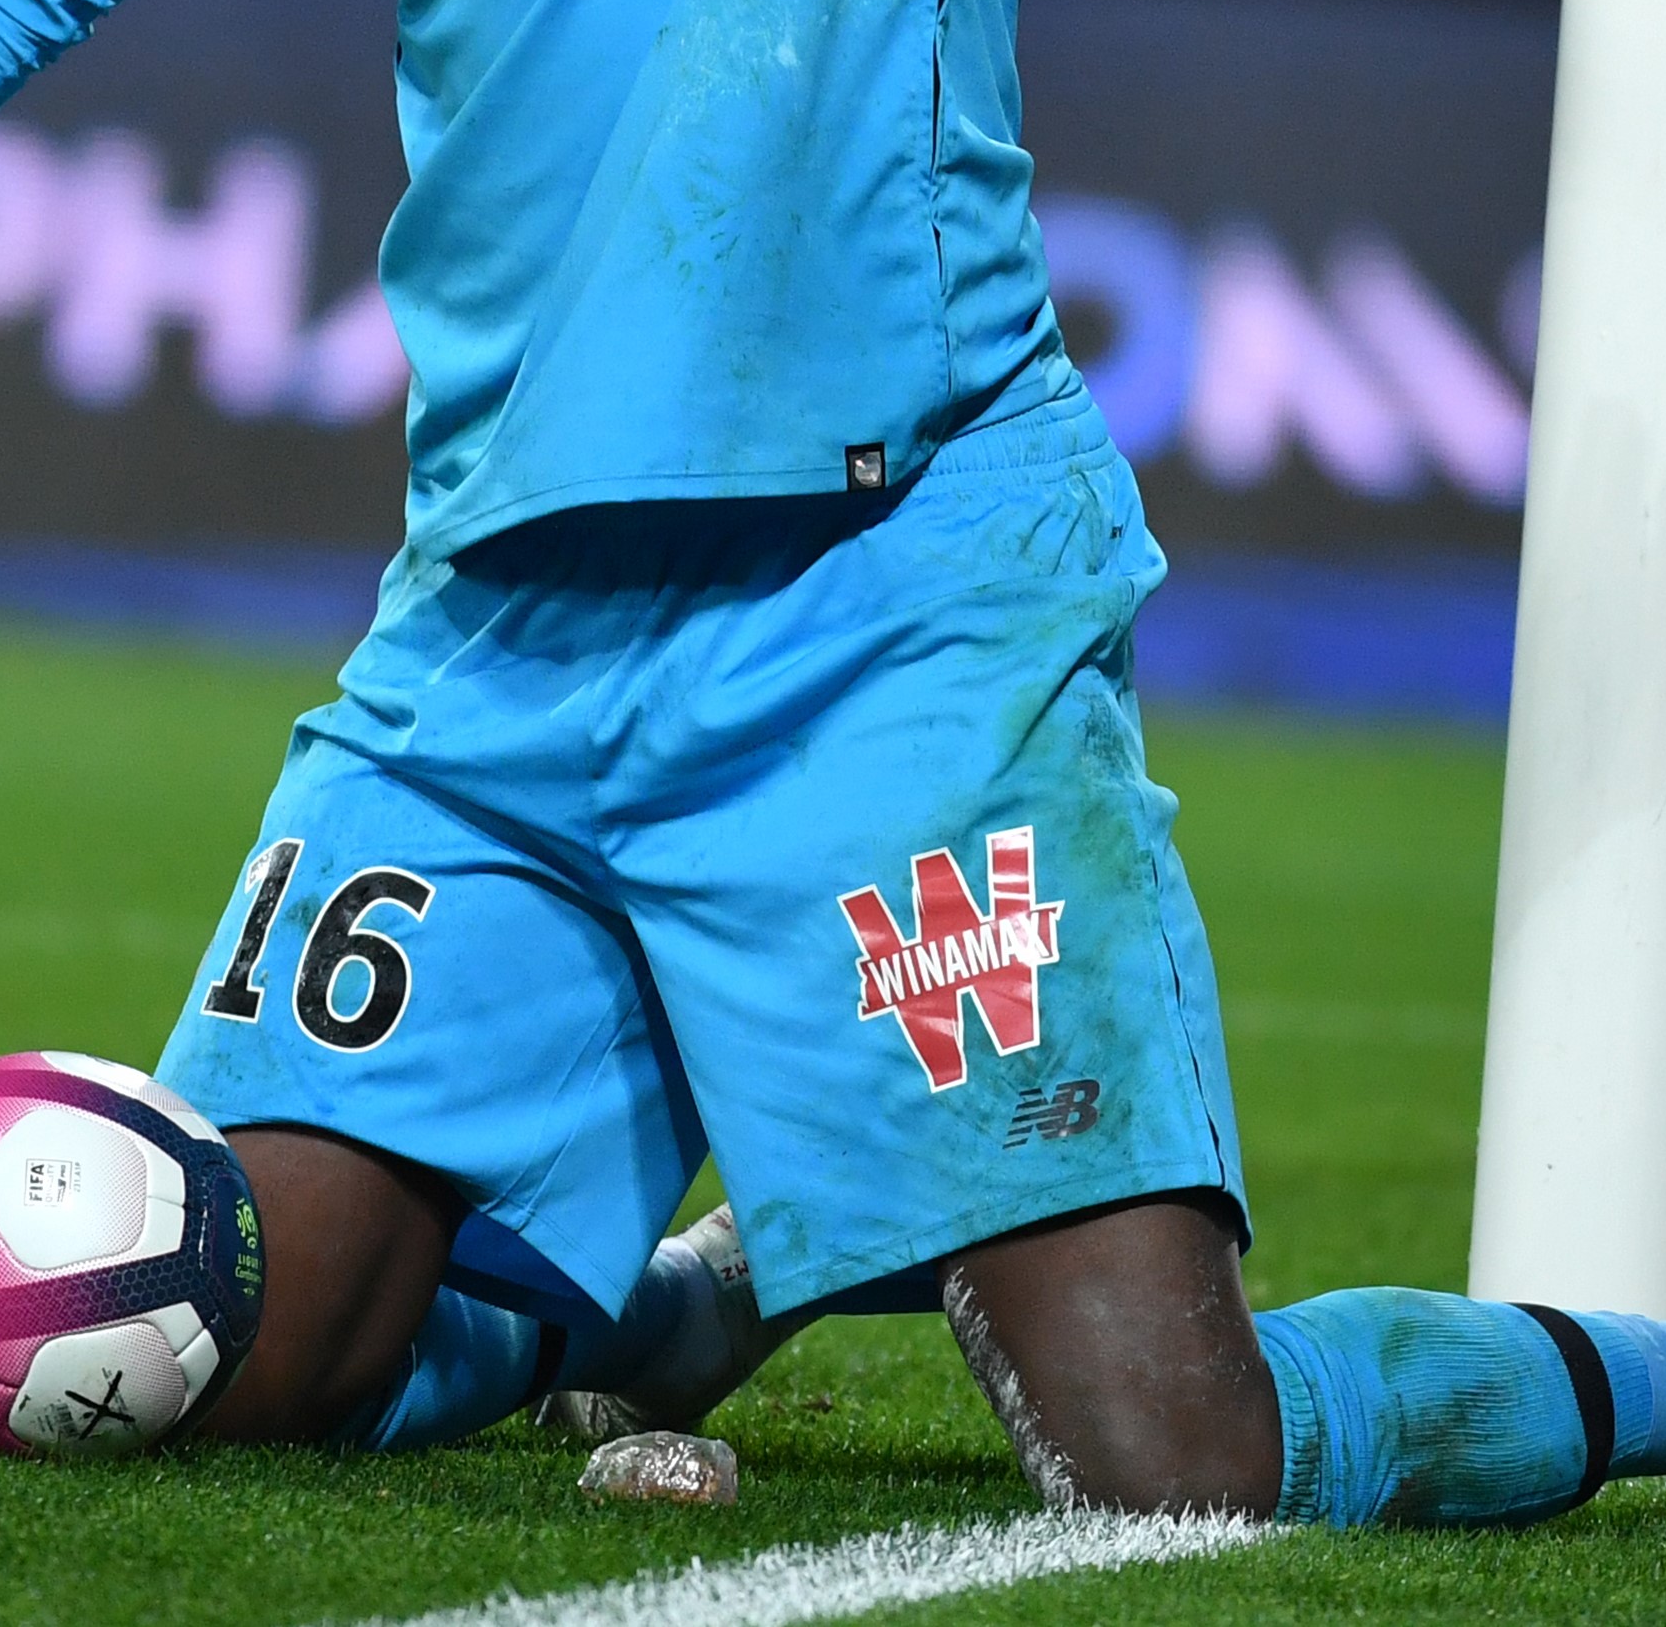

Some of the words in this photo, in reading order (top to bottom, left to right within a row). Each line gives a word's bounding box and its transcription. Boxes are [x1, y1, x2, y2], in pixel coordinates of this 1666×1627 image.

[200, 837, 436, 1055] 16
[869, 914, 1051, 1009] WINAMAX
[29, 1163, 44, 1202] FIFA
